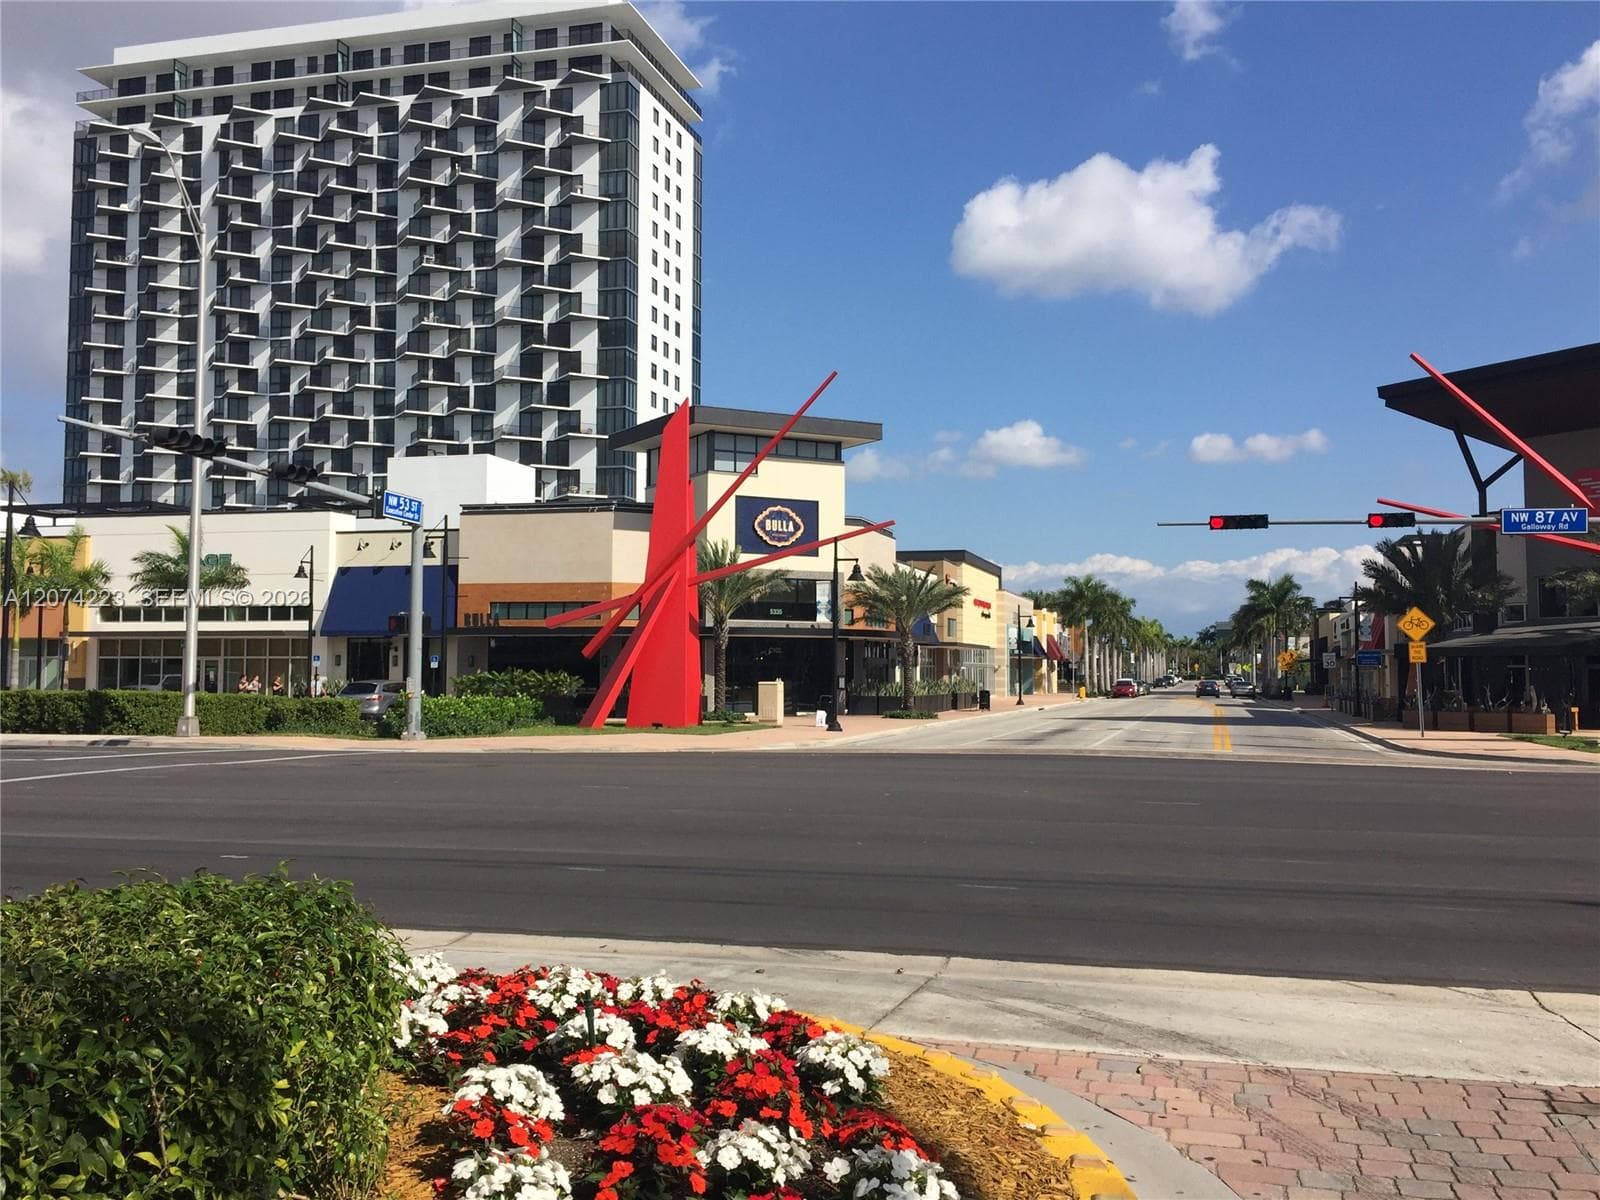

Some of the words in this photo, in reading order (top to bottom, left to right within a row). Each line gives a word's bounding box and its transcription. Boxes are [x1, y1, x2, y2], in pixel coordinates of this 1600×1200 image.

[388, 495, 398, 507] NW
[399, 497, 410, 511] 53
[411, 501, 418, 512] ST
[1511, 512, 1529, 522] NW
[1535, 511, 1555, 523] 87
[1561, 511, 1578, 522] AV
[765, 519, 794, 532] BULLA
[1521, 523, 1556, 531] Galloway
